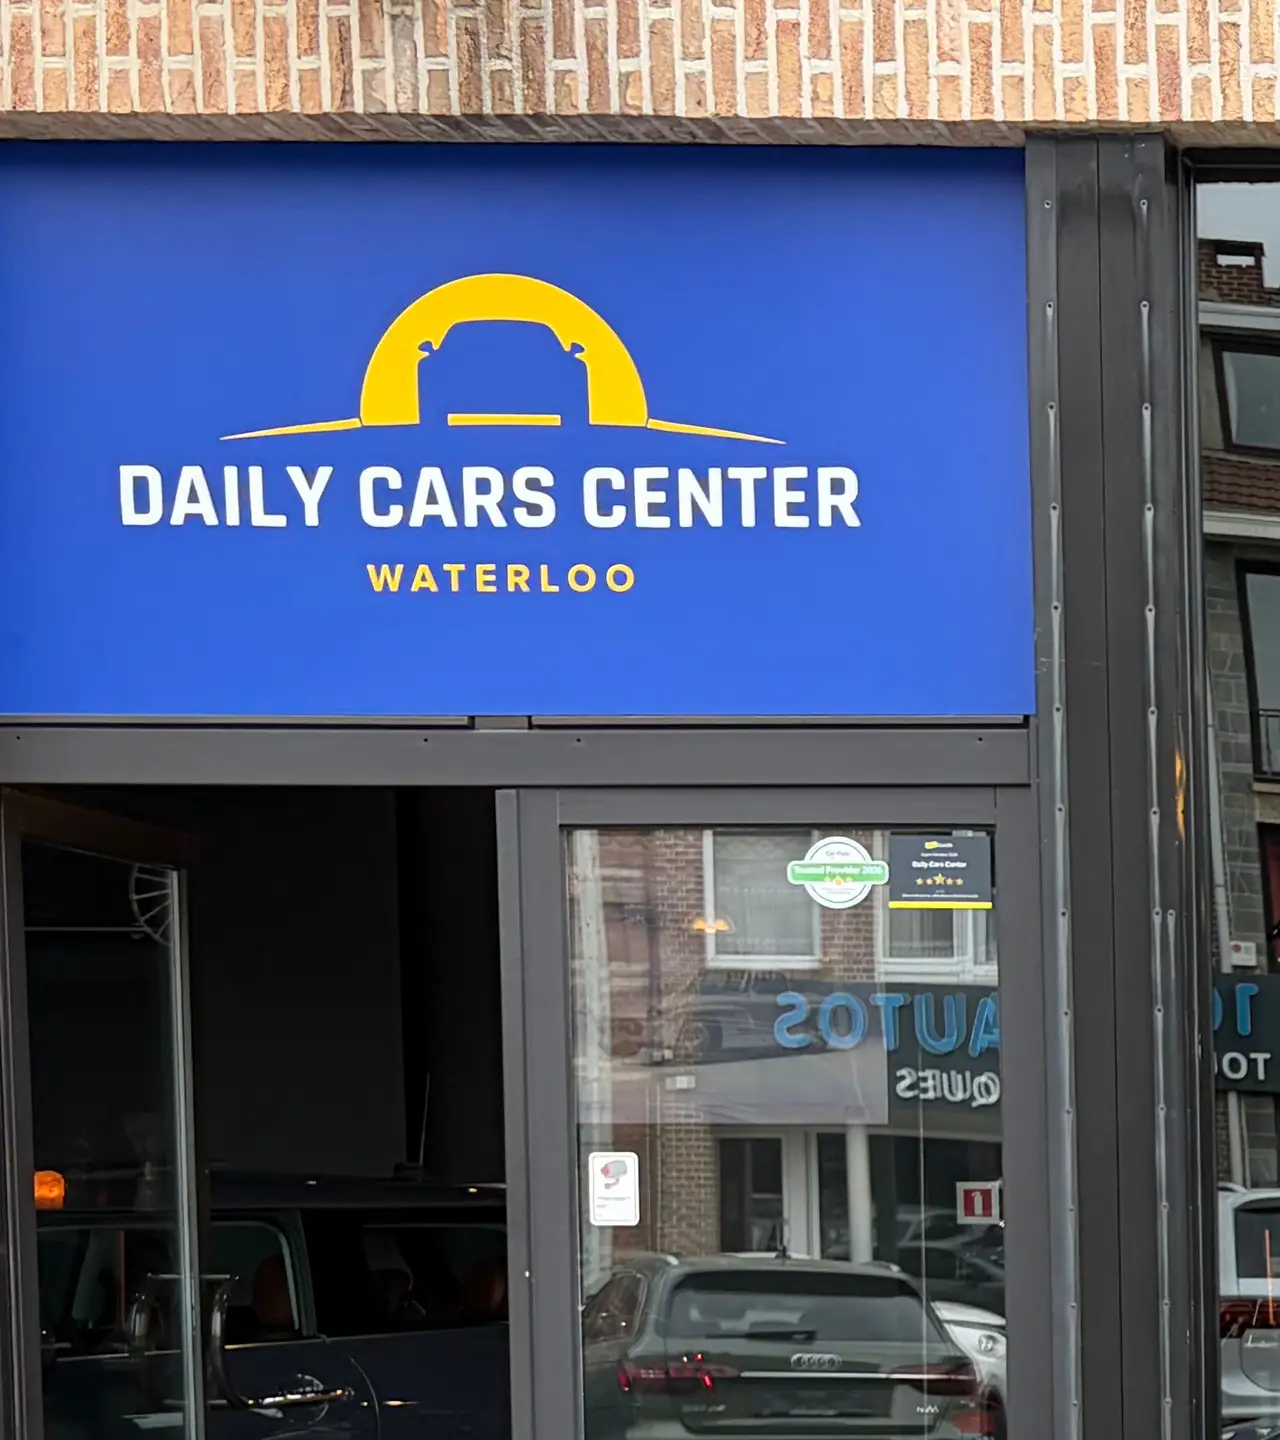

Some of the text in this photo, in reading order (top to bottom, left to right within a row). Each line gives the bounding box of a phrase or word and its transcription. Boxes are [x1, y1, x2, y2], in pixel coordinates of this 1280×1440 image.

[118, 464, 863, 528] DAILY CARS CENTER
[366, 562, 637, 593] WATERLOO
